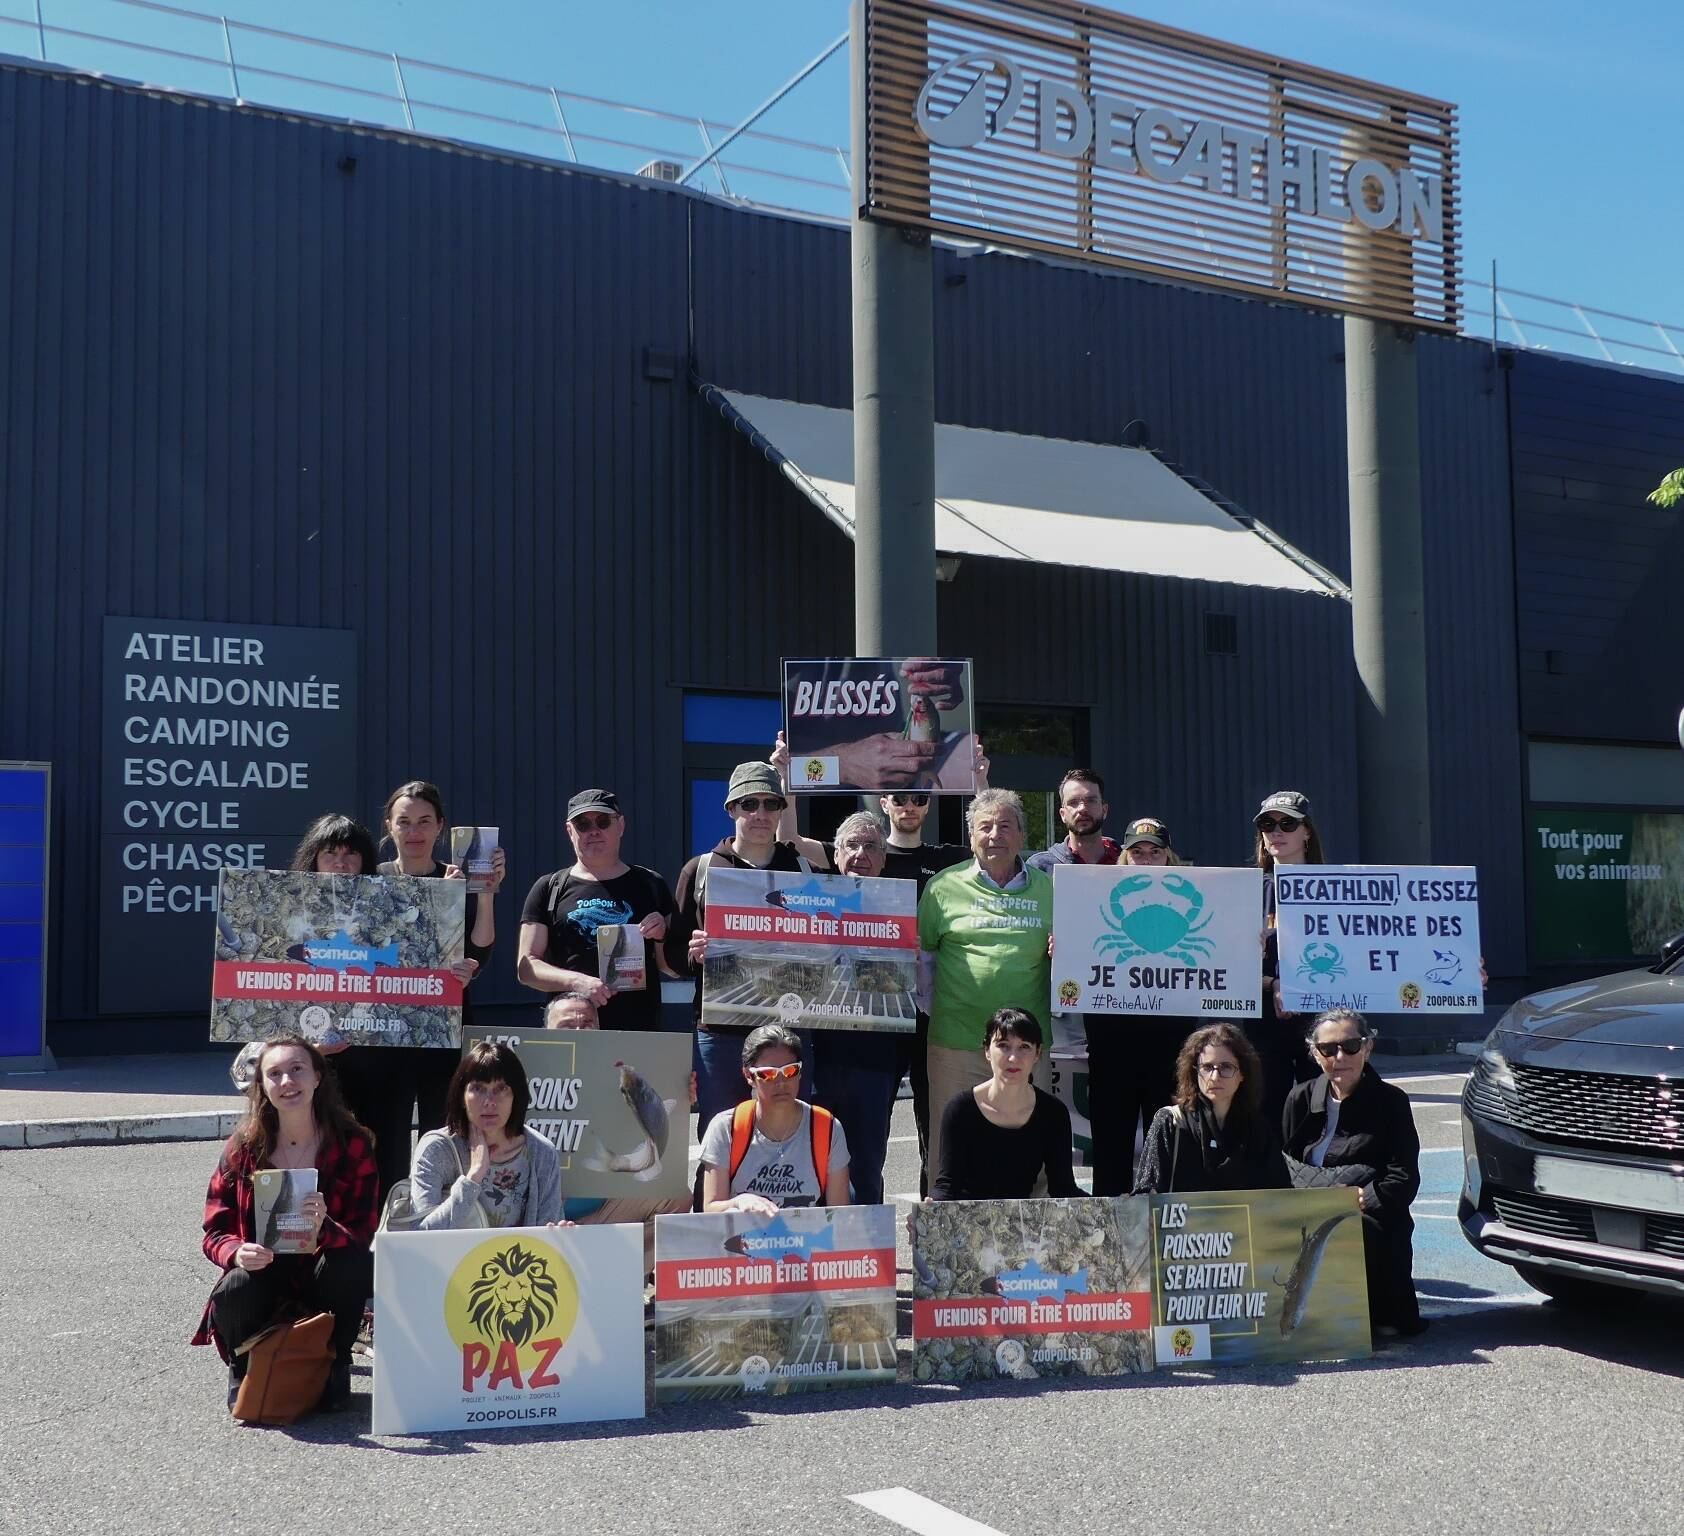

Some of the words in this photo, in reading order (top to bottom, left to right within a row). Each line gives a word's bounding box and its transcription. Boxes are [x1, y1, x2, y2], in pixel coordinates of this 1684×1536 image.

[1036, 78, 1443, 243] DECATHLON
[124, 632, 265, 665] ATELIER
[125, 674, 340, 710] RANDONNÉE
[793, 674, 899, 717] BLESSÉS
[124, 716, 290, 748] CAMPING
[124, 758, 309, 789] ESCALADE
[807, 774, 824, 782] PAZ
[123, 800, 240, 829] CYCLE
[1538, 828, 1579, 849] Tout
[1583, 834, 1624, 856] pour
[122, 843, 266, 871] CHASSE
[1554, 864, 1586, 880] vos
[1588, 858, 1662, 880] animaux
[122, 878, 218, 913] PÊCH
[988, 897, 1039, 912] RESPECTE
[1279, 878, 1398, 906] DECATHLON,
[1406, 880, 1478, 902] CESSEZ
[724, 913, 772, 932] VENDUS
[775, 917, 807, 934] POUR
[810, 915, 839, 936] ÊTRE
[842, 919, 900, 940] TORTURÉS
[991, 915, 1043, 928] ANIMAUX
[1304, 914, 1329, 936] DE
[1338, 914, 1417, 937] VENDRE
[1426, 915, 1462, 937] DES
[1368, 950, 1400, 972] ET
[236, 970, 293, 990] VENDUS
[296, 972, 334, 992] POUR
[338, 970, 371, 993] ÊTRE
[375, 974, 444, 996] TORTURÉS
[1087, 965, 1116, 987] JE
[1128, 966, 1227, 991] SOUFFRE
[810, 1003, 864, 1017] ZOOPOLIS.FR
[1059, 997, 1079, 1007] PAZ
[1091, 993, 1164, 1011] #PêcheAuVif
[1201, 998, 1256, 1011] ZOOPOLIS.FR
[1300, 993, 1368, 1010] #PêcheAuVif
[1402, 999, 1420, 1009] PAZ
[1426, 995, 1478, 1007] ZOOPOLIS.FR
[338, 1016, 401, 1032] ZOOPOLIS.FR
[527, 1077, 583, 1111] SONS
[757, 1163, 795, 1179] AGIR
[746, 1178, 804, 1194] ANIMAUX
[1161, 1203, 1188, 1229] LES
[1162, 1231, 1233, 1260] POISSONS
[677, 1268, 732, 1289] VENDUS
[736, 1264, 772, 1285] POUR
[776, 1259, 808, 1283] ÊTRE
[812, 1255, 878, 1280] TORTURÉS
[1164, 1265, 1185, 1290] SE
[1185, 1262, 1248, 1290] BATTENT
[934, 1307, 987, 1327] VENDUS
[991, 1306, 1027, 1325] POUR
[1030, 1302, 1062, 1324] ÊTRE
[1066, 1298, 1132, 1321] TORTURÉS
[1167, 1295, 1206, 1321] POUR
[1207, 1293, 1244, 1320] LEUR
[1245, 1292, 1268, 1317] VIE
[462, 1336, 563, 1393] PAZ
[1032, 1347, 1092, 1363] ZOOPOLIS.FR
[1174, 1347, 1192, 1357] PAZ
[778, 1361, 839, 1378] ZOOPOLIS.FR
[528, 1391, 561, 1400] ZOOPOLIS
[466, 1407, 557, 1423] ZOOPOLIS.FR
